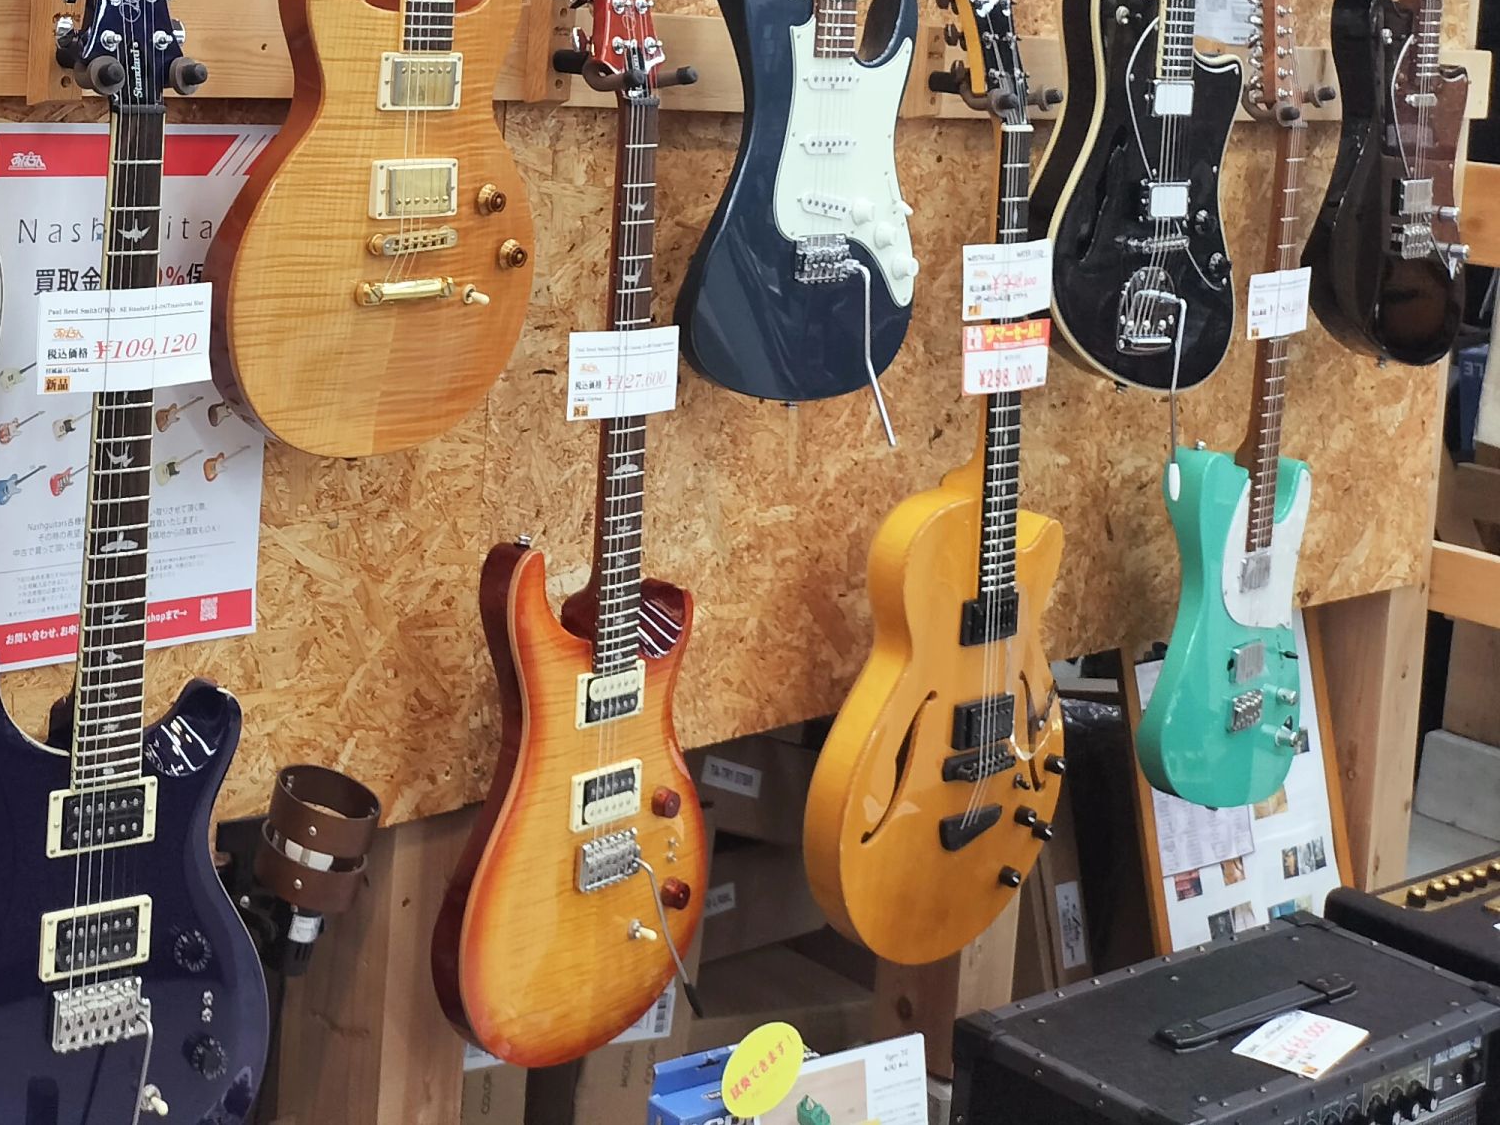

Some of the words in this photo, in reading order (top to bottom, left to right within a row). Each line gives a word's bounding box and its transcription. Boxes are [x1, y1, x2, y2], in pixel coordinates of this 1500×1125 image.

[47, 346, 88, 360] 税込価格
[45, 377, 69, 392] 新品
